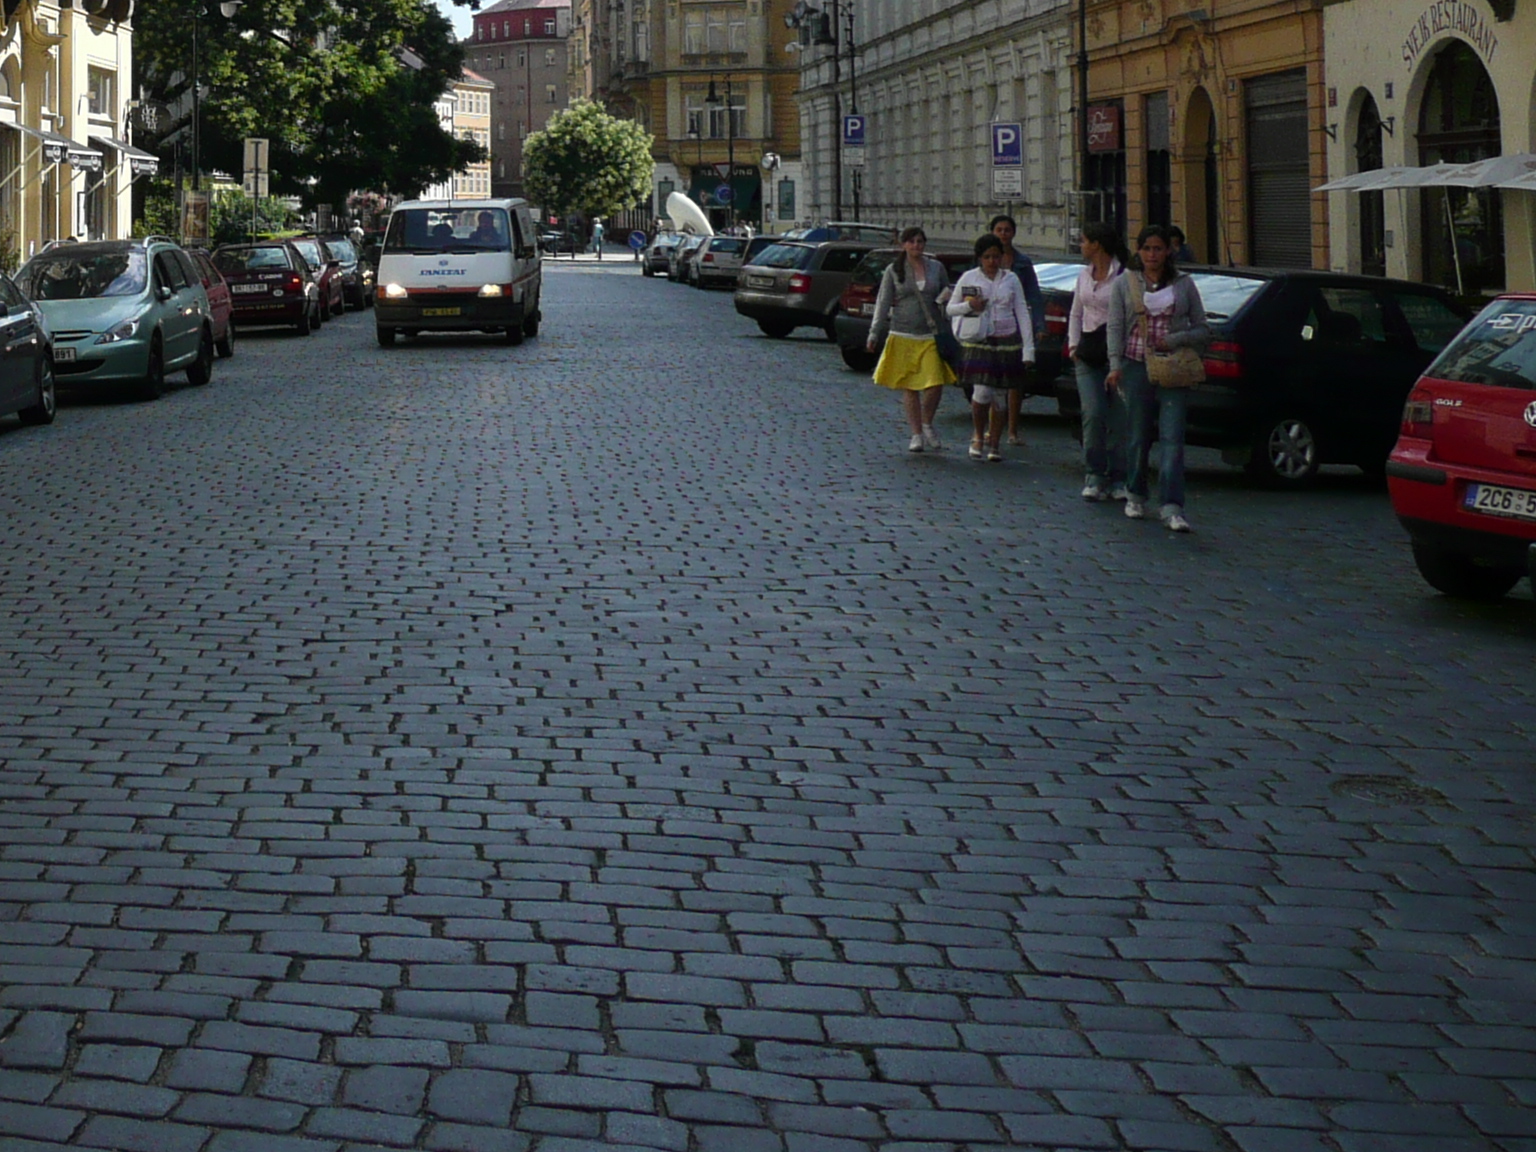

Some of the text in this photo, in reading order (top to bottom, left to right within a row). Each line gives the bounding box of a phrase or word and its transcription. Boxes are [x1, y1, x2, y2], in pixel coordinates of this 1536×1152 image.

[1401, 10, 1431, 73] ŠVEJK
[847, 118, 861, 137] P
[997, 128, 1016, 154] P
[1435, 397, 1463, 408] GOLF
[1479, 488, 1514, 509] 2C6
